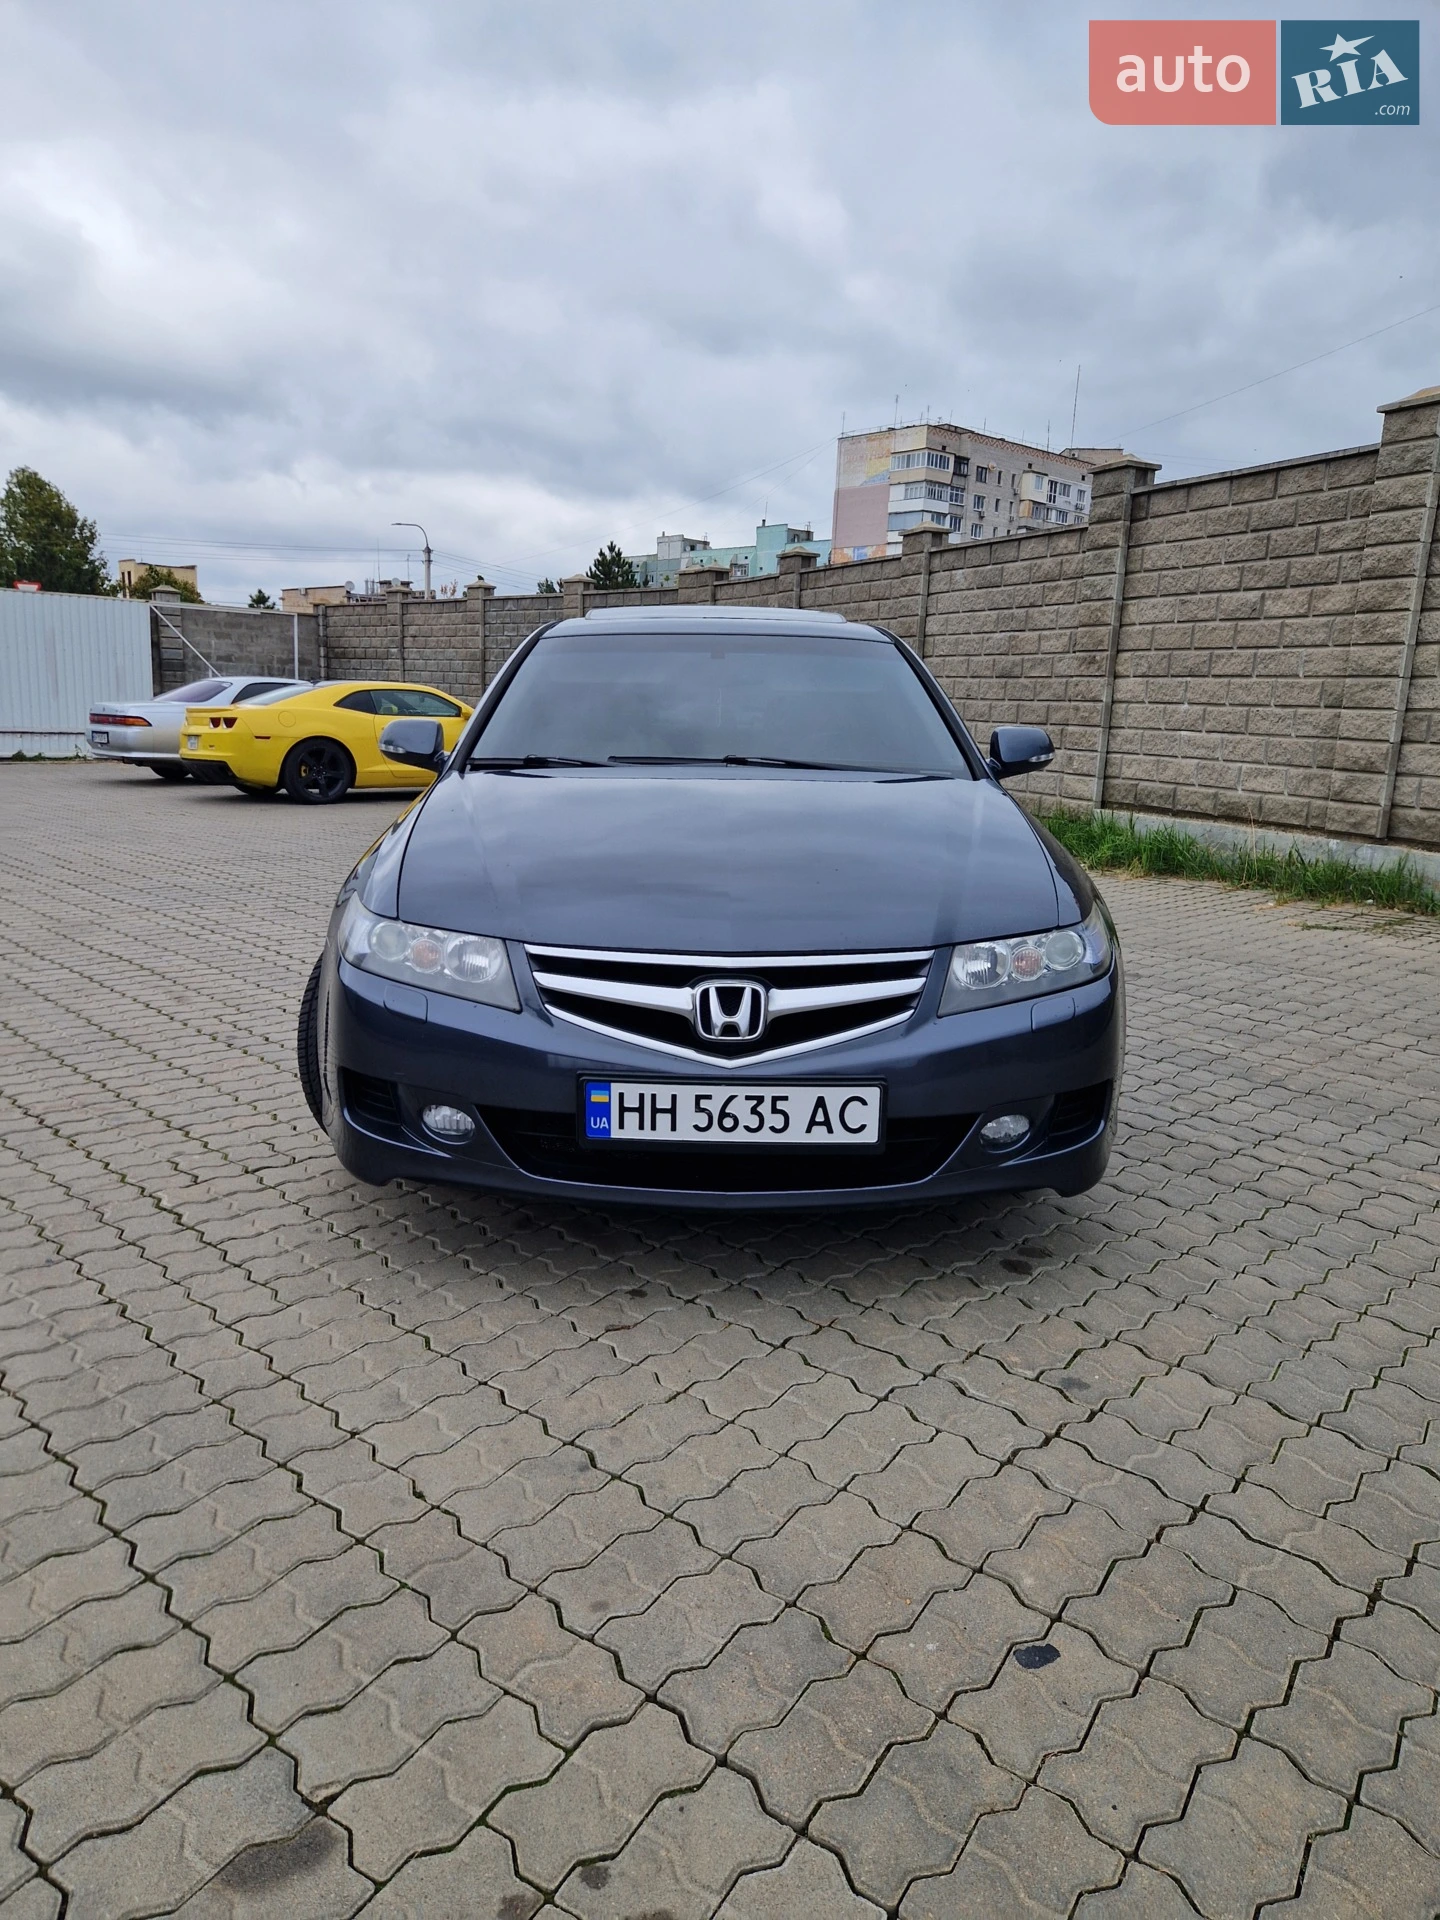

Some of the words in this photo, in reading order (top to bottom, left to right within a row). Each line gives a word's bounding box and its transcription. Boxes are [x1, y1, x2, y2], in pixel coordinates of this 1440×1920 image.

[591, 1117, 609, 1129] UA
[618, 1092, 677, 1132] HH
[692, 1094, 790, 1133] 5635
[805, 1095, 869, 1134] AC
